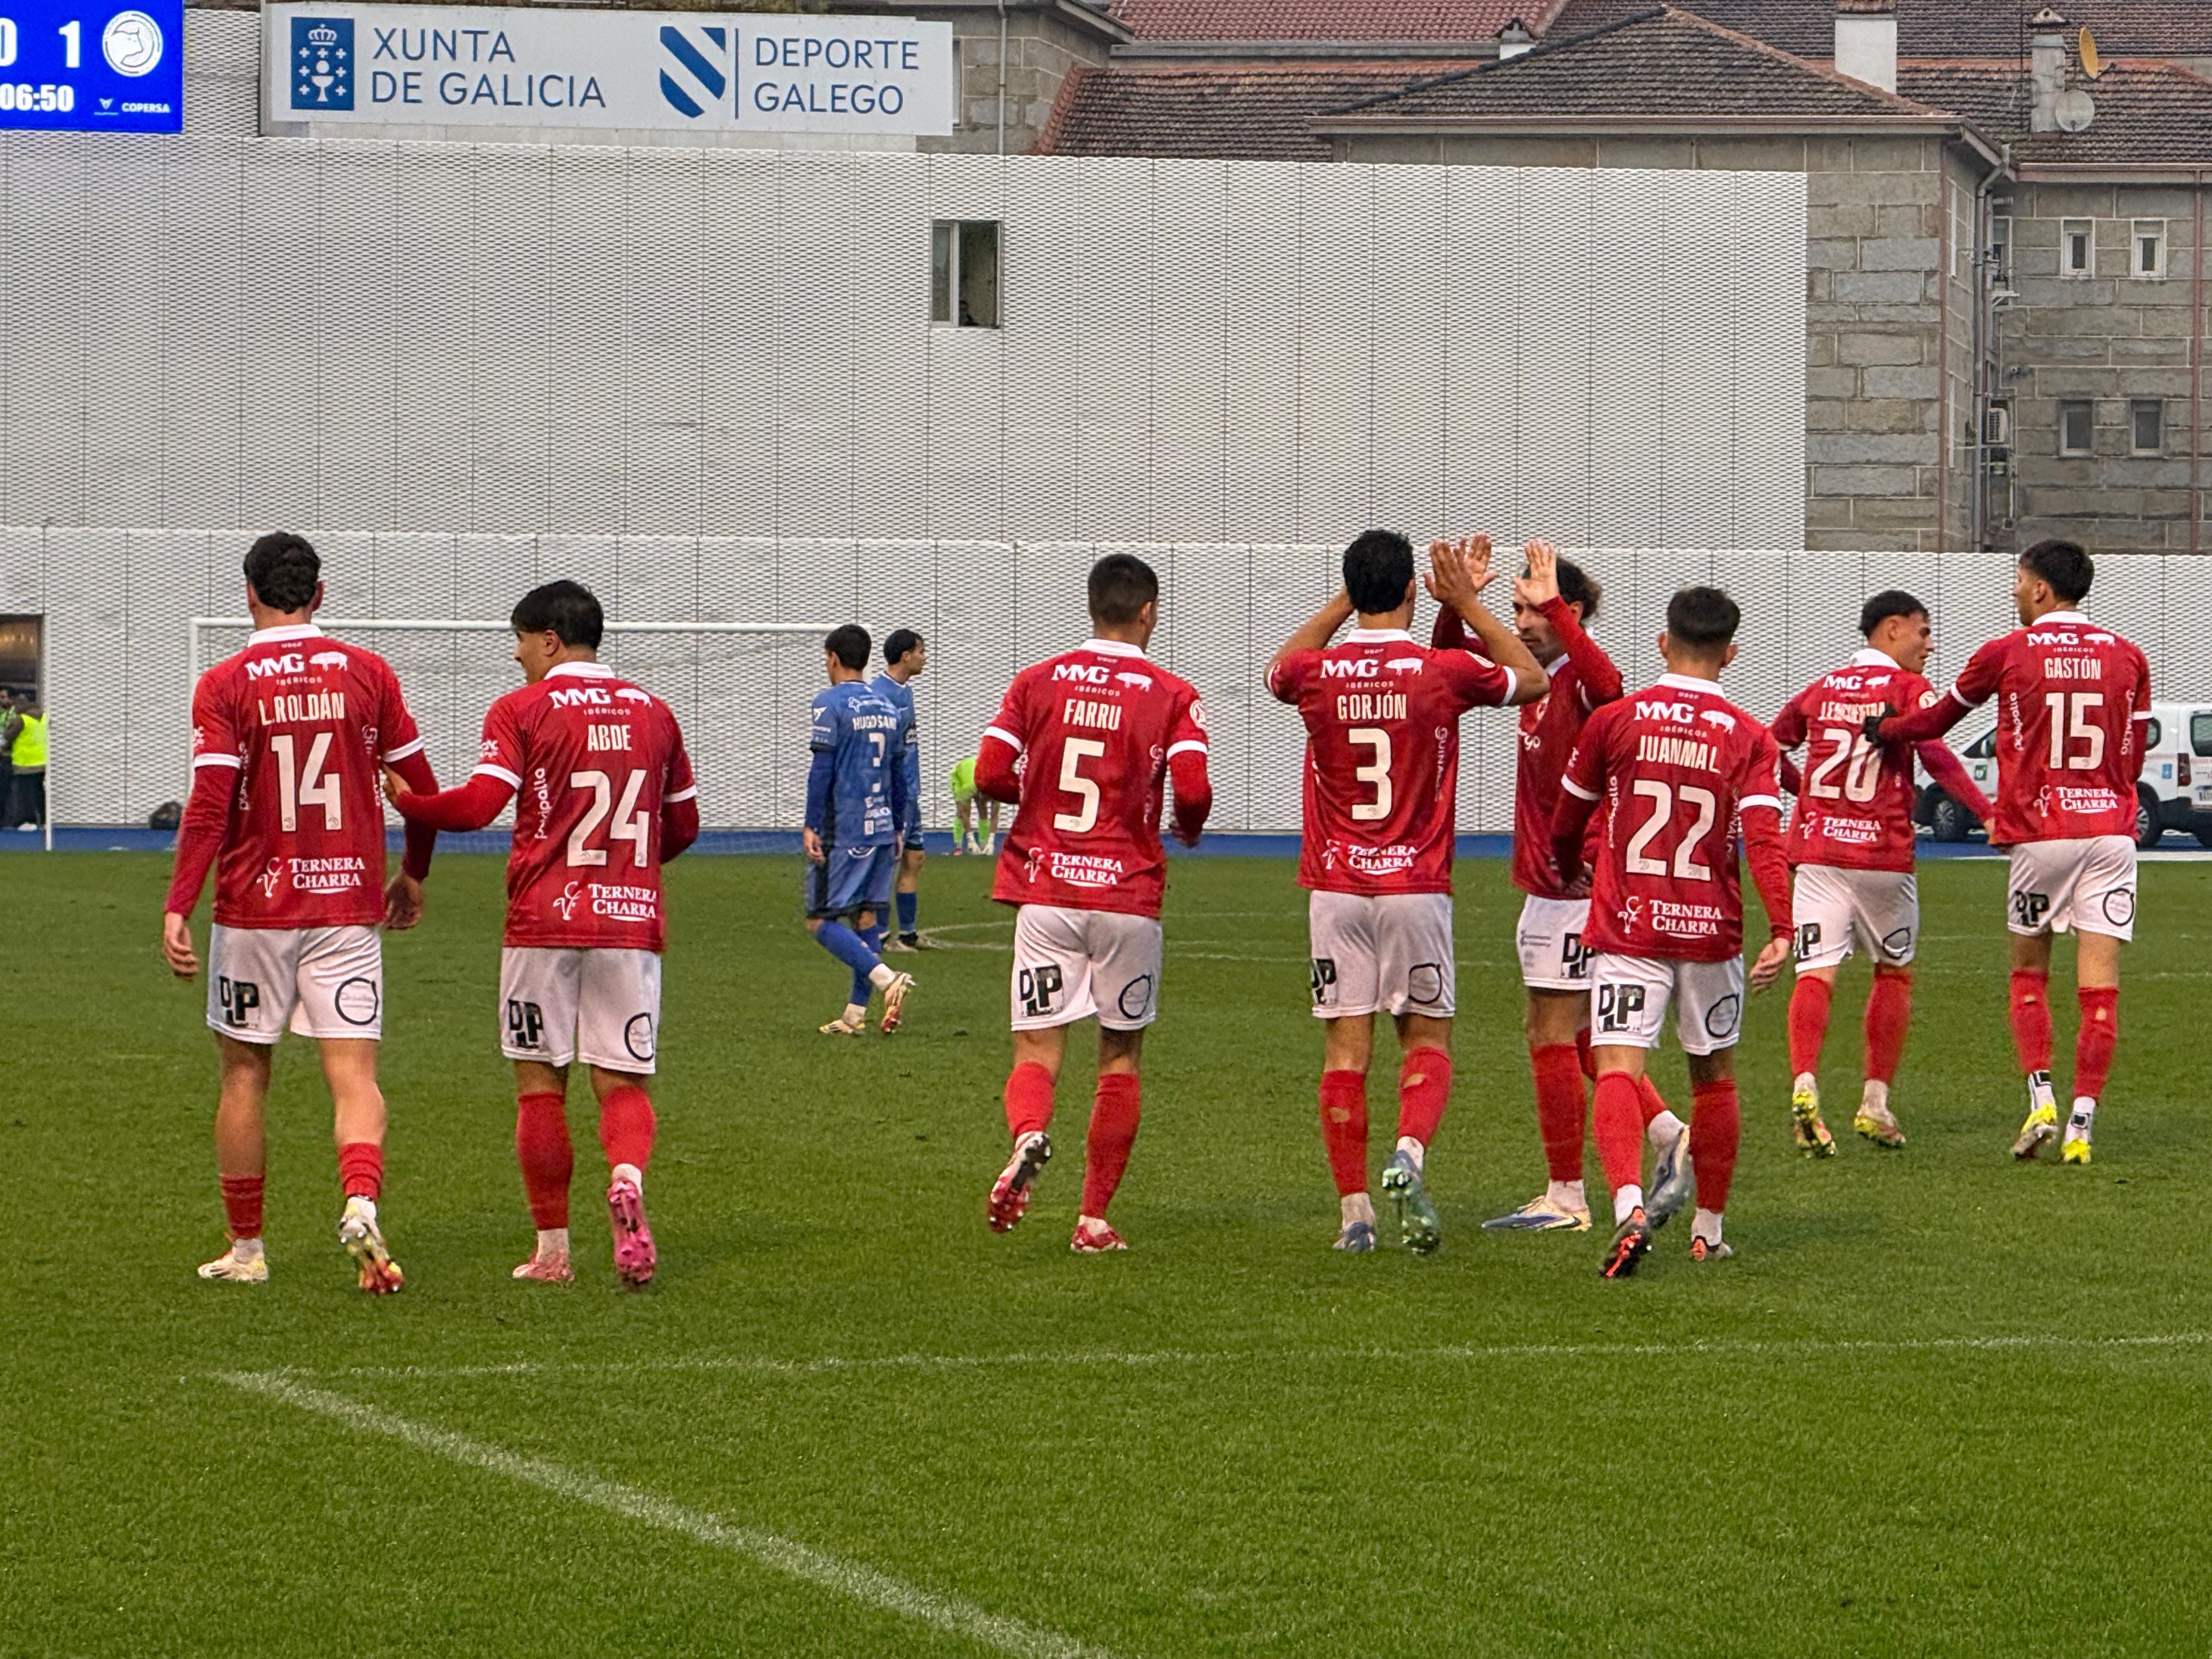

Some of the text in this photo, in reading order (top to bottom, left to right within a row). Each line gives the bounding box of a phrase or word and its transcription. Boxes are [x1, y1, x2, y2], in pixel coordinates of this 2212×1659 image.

[58, 20, 80, 68] 1
[373, 27, 516, 63] XUNTA
[755, 37, 919, 70] DEPORTE
[372, 71, 606, 108] DE GALICIA
[754, 82, 904, 115] GALEGO
[121, 103, 171, 113] COPERSA
[2027, 633, 2079, 646] MMG
[245, 653, 304, 680] MMG
[1051, 664, 1110, 684] MMG
[1320, 658, 1379, 679] MMG
[2045, 655, 2101, 680] GASTÓN
[549, 688, 611, 709] MMG
[1337, 690, 1407, 720] GORJÓN
[1063, 698, 1122, 731] FARRU
[1634, 701, 1694, 724] MMG
[588, 724, 632, 752] ABDE
[2045, 692, 2105, 770] 15
[868, 732, 885, 793] 7
[1348, 728, 1392, 820] 3
[1809, 727, 1882, 803] 20
[271, 732, 342, 832] 14
[1053, 737, 1105, 833] 5
[2056, 786, 2118, 799] TERNERA
[2061, 798, 2118, 811] CHARRA
[567, 769, 650, 867] 24
[1626, 779, 1716, 881] 22
[1822, 816, 1882, 831] TERNERA
[1823, 826, 1877, 842] CHARRA
[288, 857, 365, 873] TERNERA
[1051, 853, 1123, 873] TERNERA
[1348, 855, 1414, 870] CHARRA
[292, 873, 362, 889] CHARRA
[1051, 865, 1118, 885] CHARRA
[592, 899, 657, 919] CHARRA
[1649, 899, 1722, 920] TERNERA
[1652, 916, 1718, 935] CHARRA
